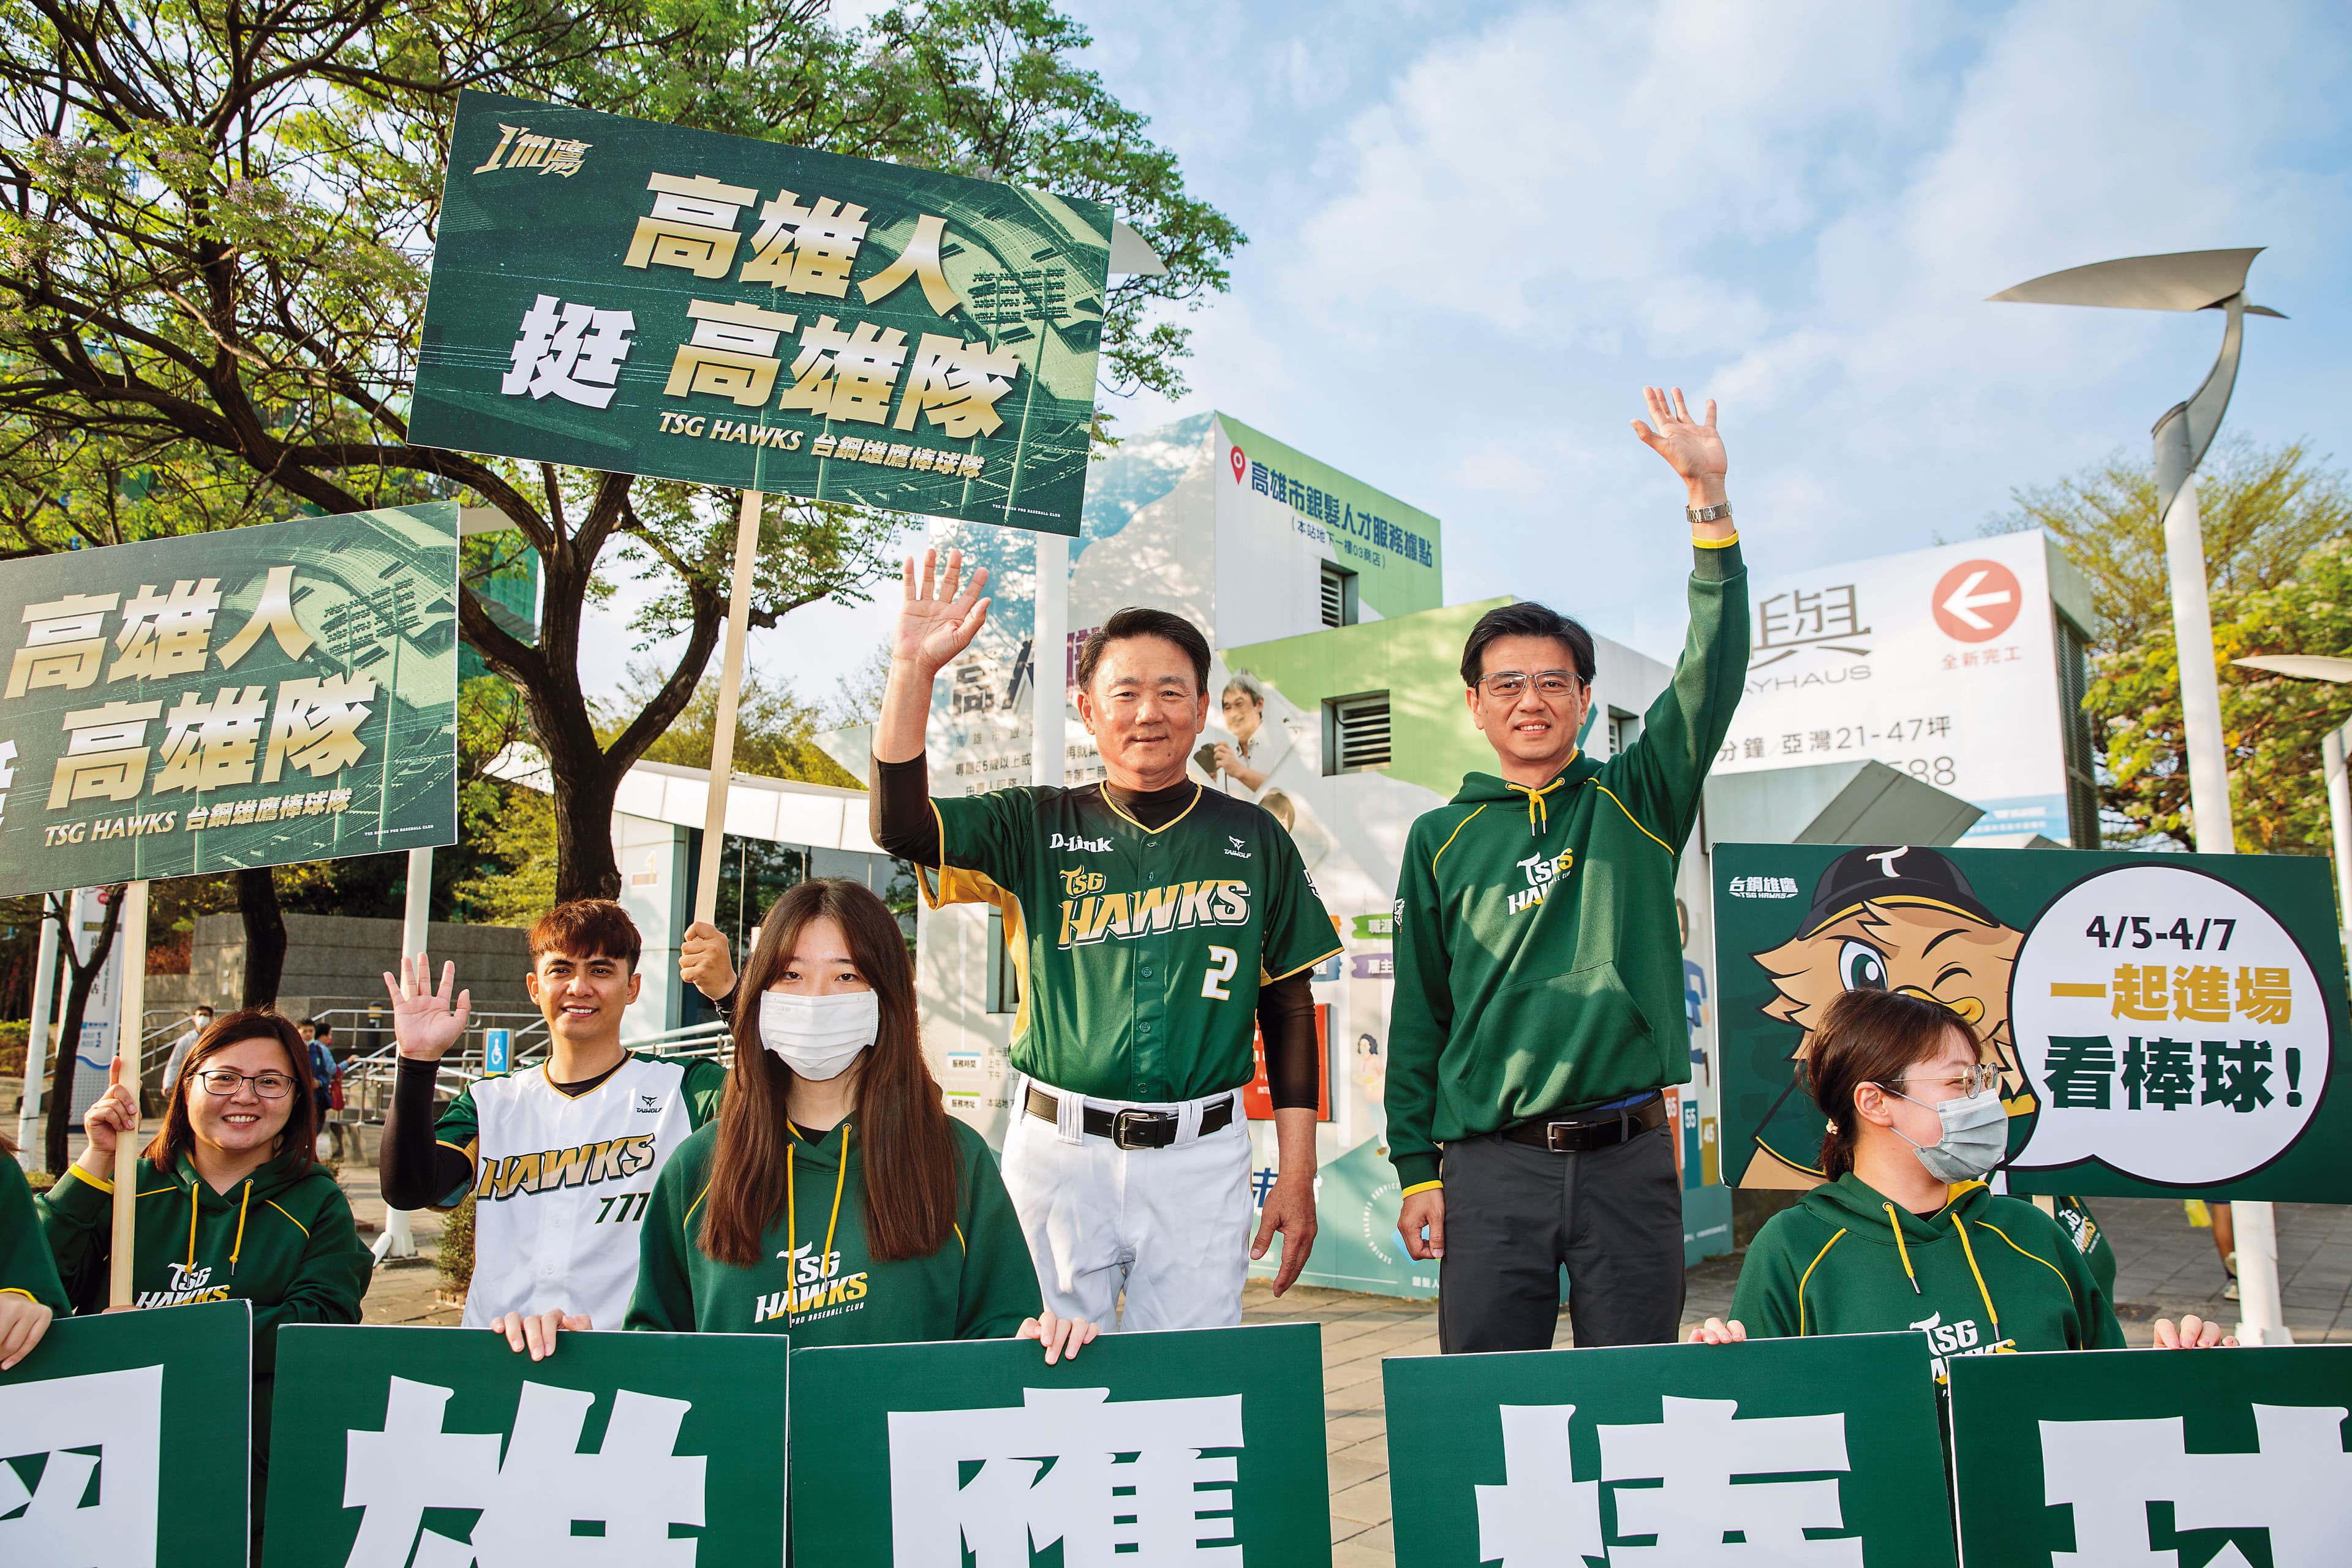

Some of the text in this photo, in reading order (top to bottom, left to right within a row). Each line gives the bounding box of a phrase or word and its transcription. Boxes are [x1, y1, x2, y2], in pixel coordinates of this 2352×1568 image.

[623, 172, 962, 318] 高雄人
[501, 293, 1020, 439] 挺 高雄隊
[658, 412, 986, 478] TSG HAWKS 台鋼雄鷹棒球隊
[3, 564, 316, 699] 高雄人
[1942, 646, 2022, 671] 全新完工
[46, 672, 379, 810] 高雄隊
[44, 787, 353, 847] TSG HAWKS 台鋼雄鷹棒球隊
[1049, 833, 1114, 853] D-Link
[1224, 848, 1252, 859] TAIWOLF
[1059, 864, 1107, 899] TSG
[1728, 876, 1798, 892] 台鋼雄鷹
[1057, 879, 1251, 950] HAWKS
[2086, 915, 2237, 951] 4/5-4/7
[1200, 945, 1238, 1001] 2
[2049, 963, 2293, 1025] 一起進場
[2043, 1035, 2304, 1113] 看棒球!
[1684, 1107, 1697, 1129] 55
[1703, 1123, 1715, 1144] 45
[477, 1132, 655, 1202] HAWKS
[595, 1191, 650, 1225] 777
[167, 1261, 212, 1291] TSG
[776, 1241, 841, 1287] TSG
[754, 1272, 868, 1324] HAWKS
[791, 1302, 864, 1325] PRO BASEBALL CLUB
